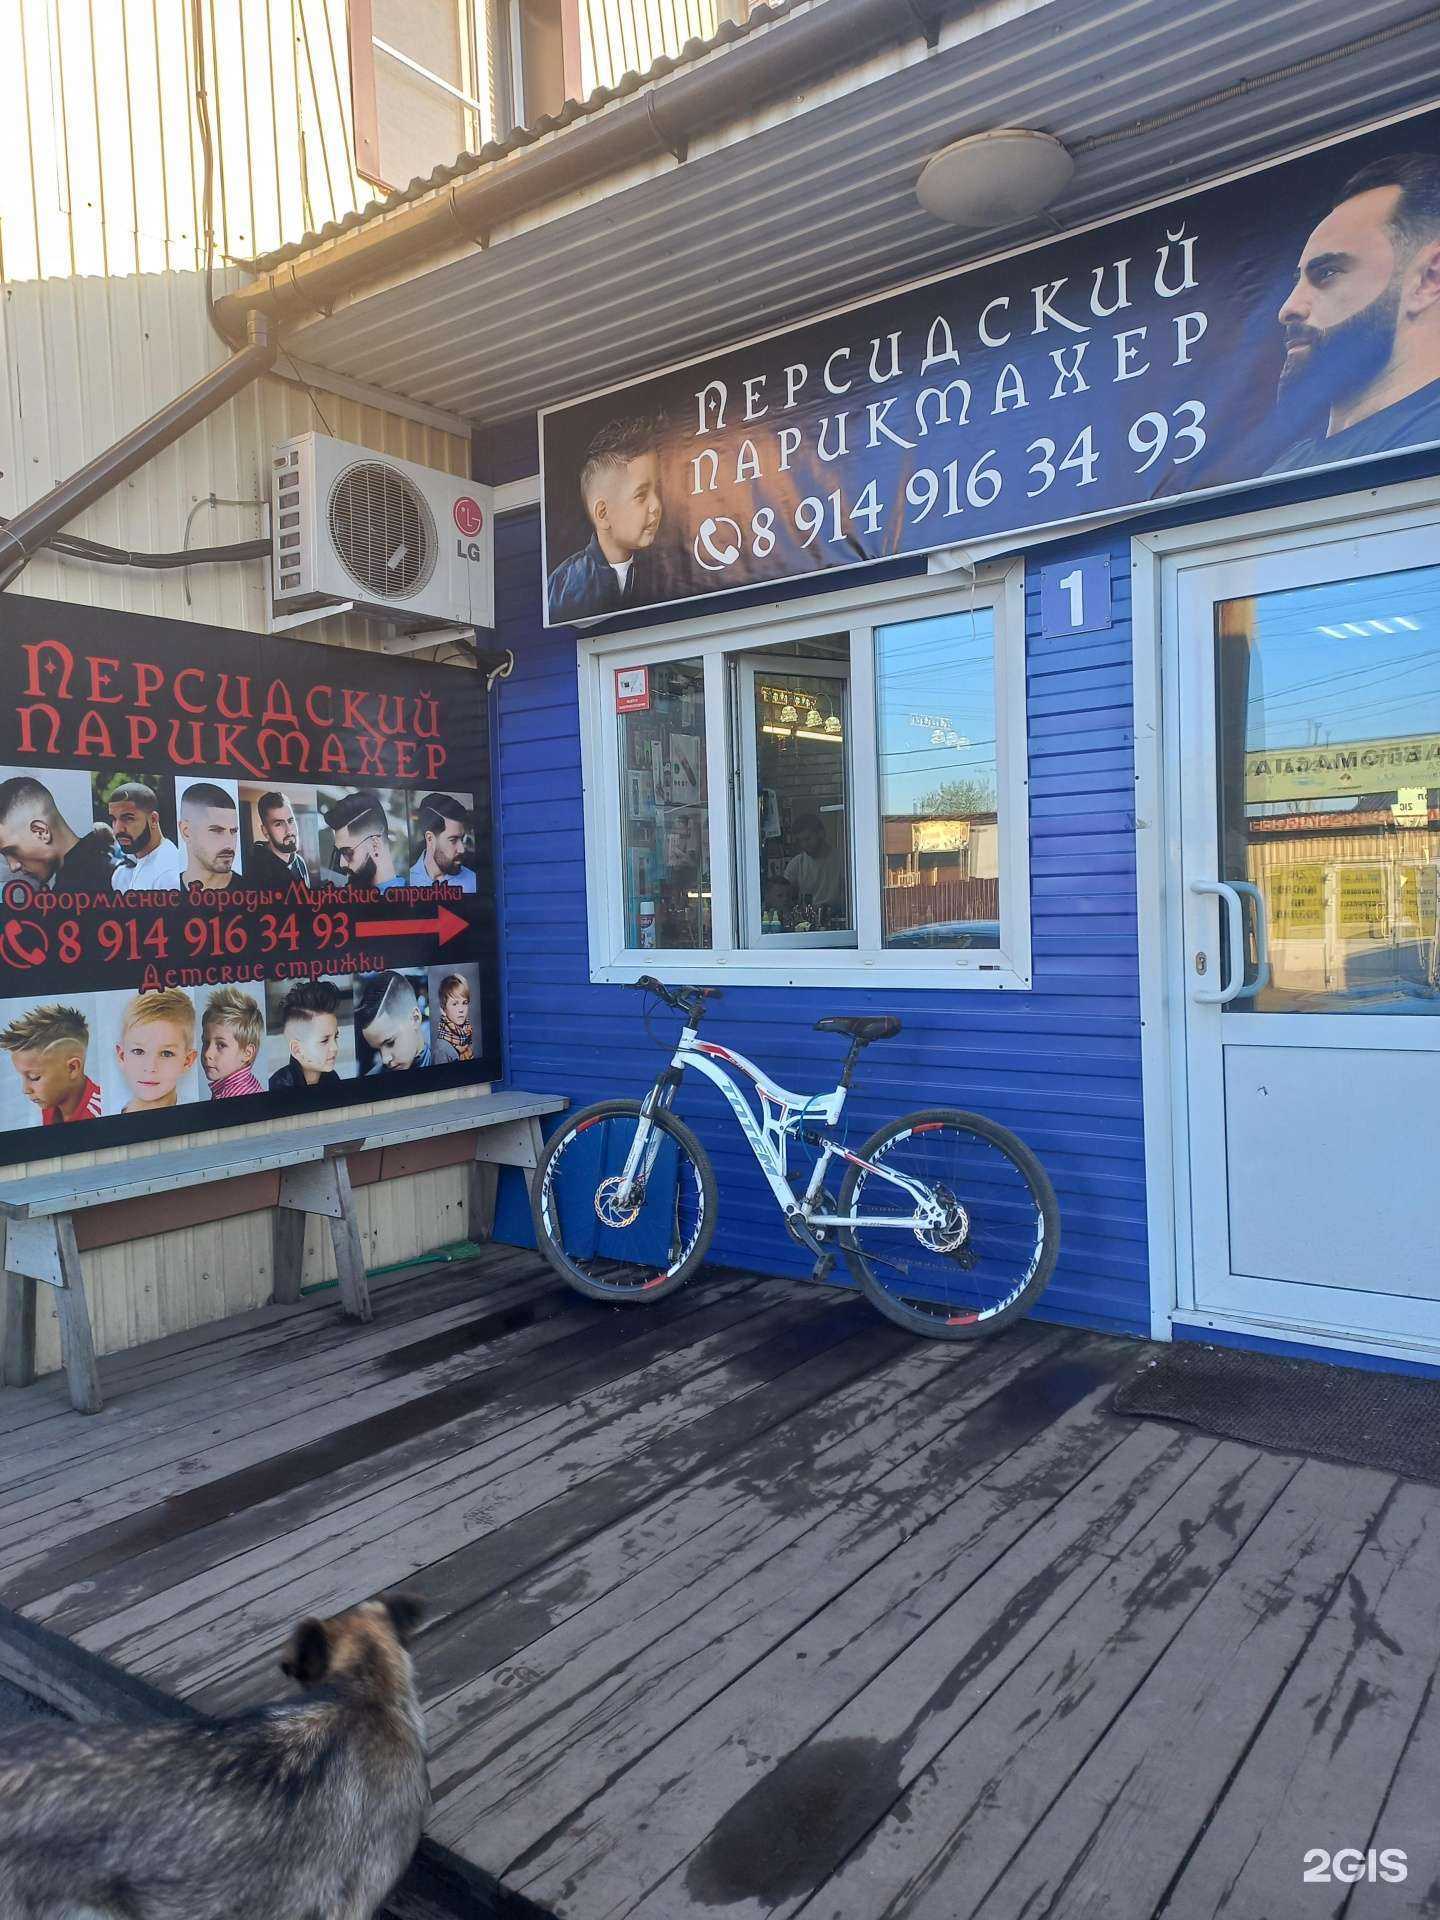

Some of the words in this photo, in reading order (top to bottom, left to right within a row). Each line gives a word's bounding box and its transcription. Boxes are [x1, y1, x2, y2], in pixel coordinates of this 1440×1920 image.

[694, 221, 1199, 436] ПЕРСИДСКИЙ
[690, 310, 1209, 496] ПАРИКМАХЕР
[751, 507, 776, 558] 8
[794, 479, 884, 549] 914
[905, 449, 1003, 524] 916
[1025, 425, 1100, 498] 34
[1128, 400, 1208, 475] 93
[456, 539, 481, 562] LG
[1058, 568, 1085, 628] 1
[21, 638, 441, 742] ПЕРСИДСКИЙ
[15, 702, 448, 780] ПАРИКМАХЕР
[3, 881, 181, 916] Оформление
[57, 919, 83, 964] 8
[97, 917, 169, 962] 914
[184, 914, 249, 957] 916
[259, 912, 300, 953] 34
[312, 911, 350, 950] 93
[275, 951, 386, 981] стрижки
